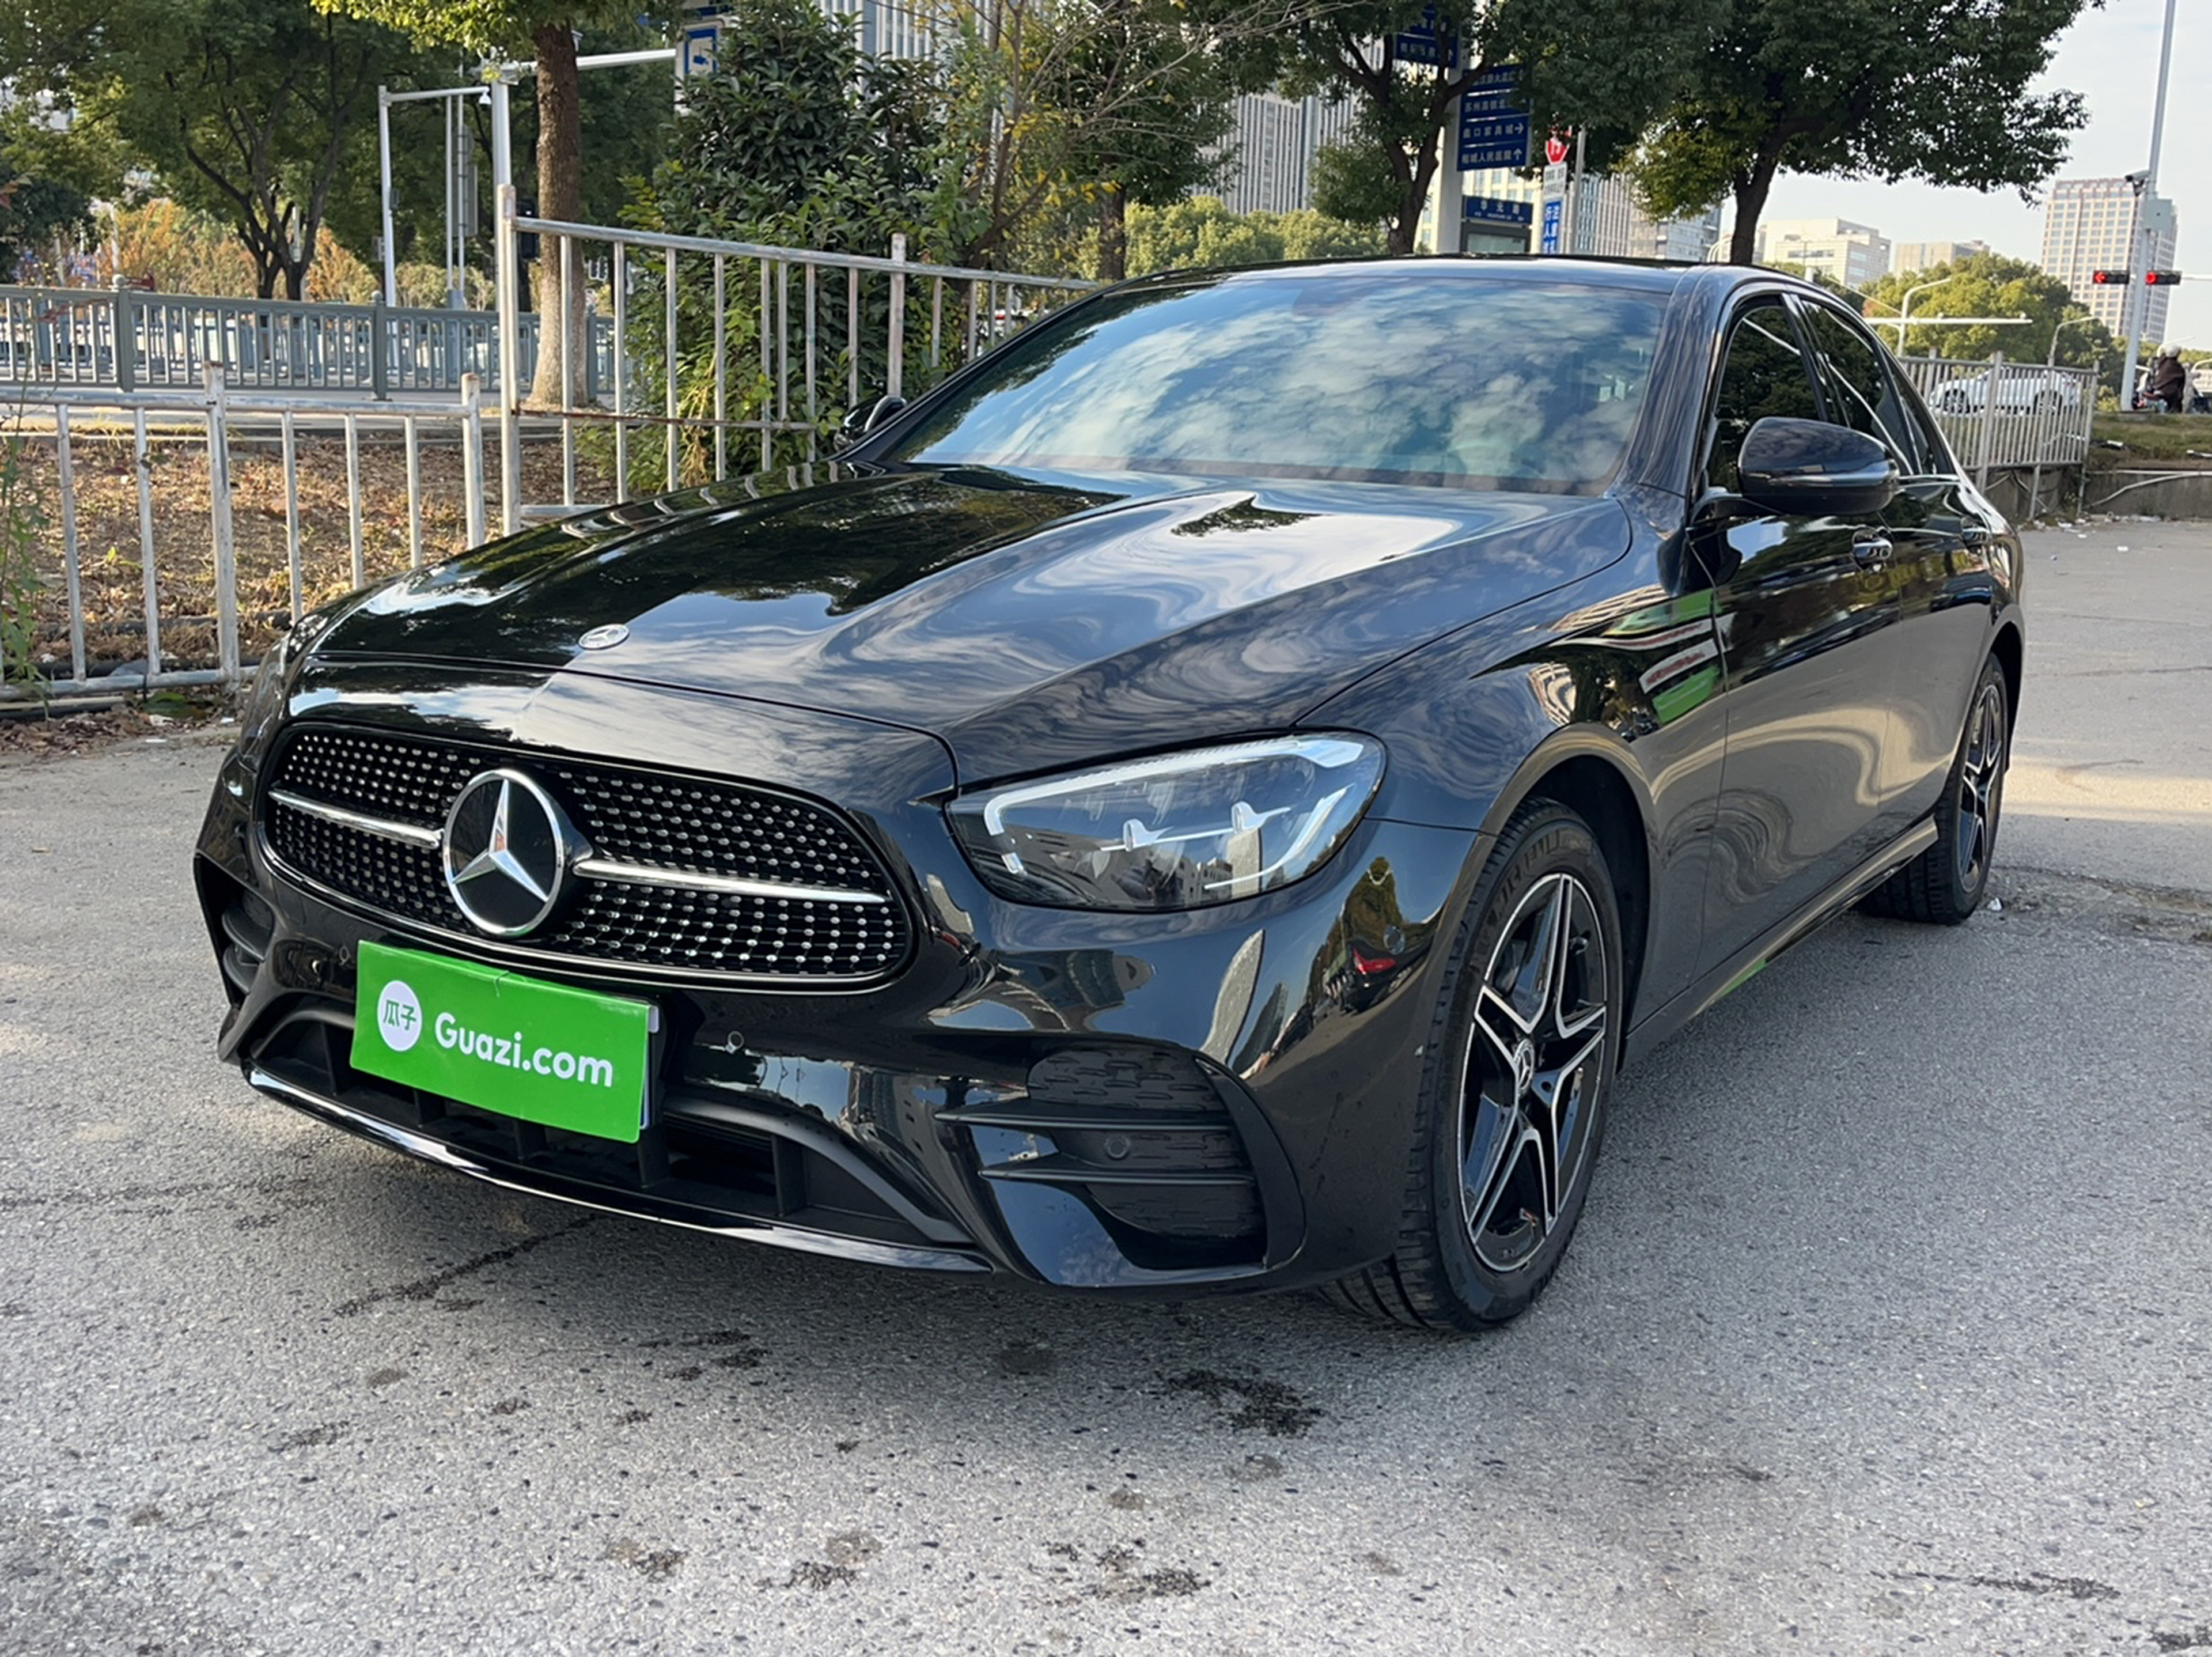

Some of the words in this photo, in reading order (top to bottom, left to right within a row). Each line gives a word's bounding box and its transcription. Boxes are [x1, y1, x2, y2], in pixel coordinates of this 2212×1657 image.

[1464, 99, 1513, 113] 苏州高铁北
[383, 1000, 416, 1031] 瓜子
[435, 1013, 612, 1087] Guazi.com
